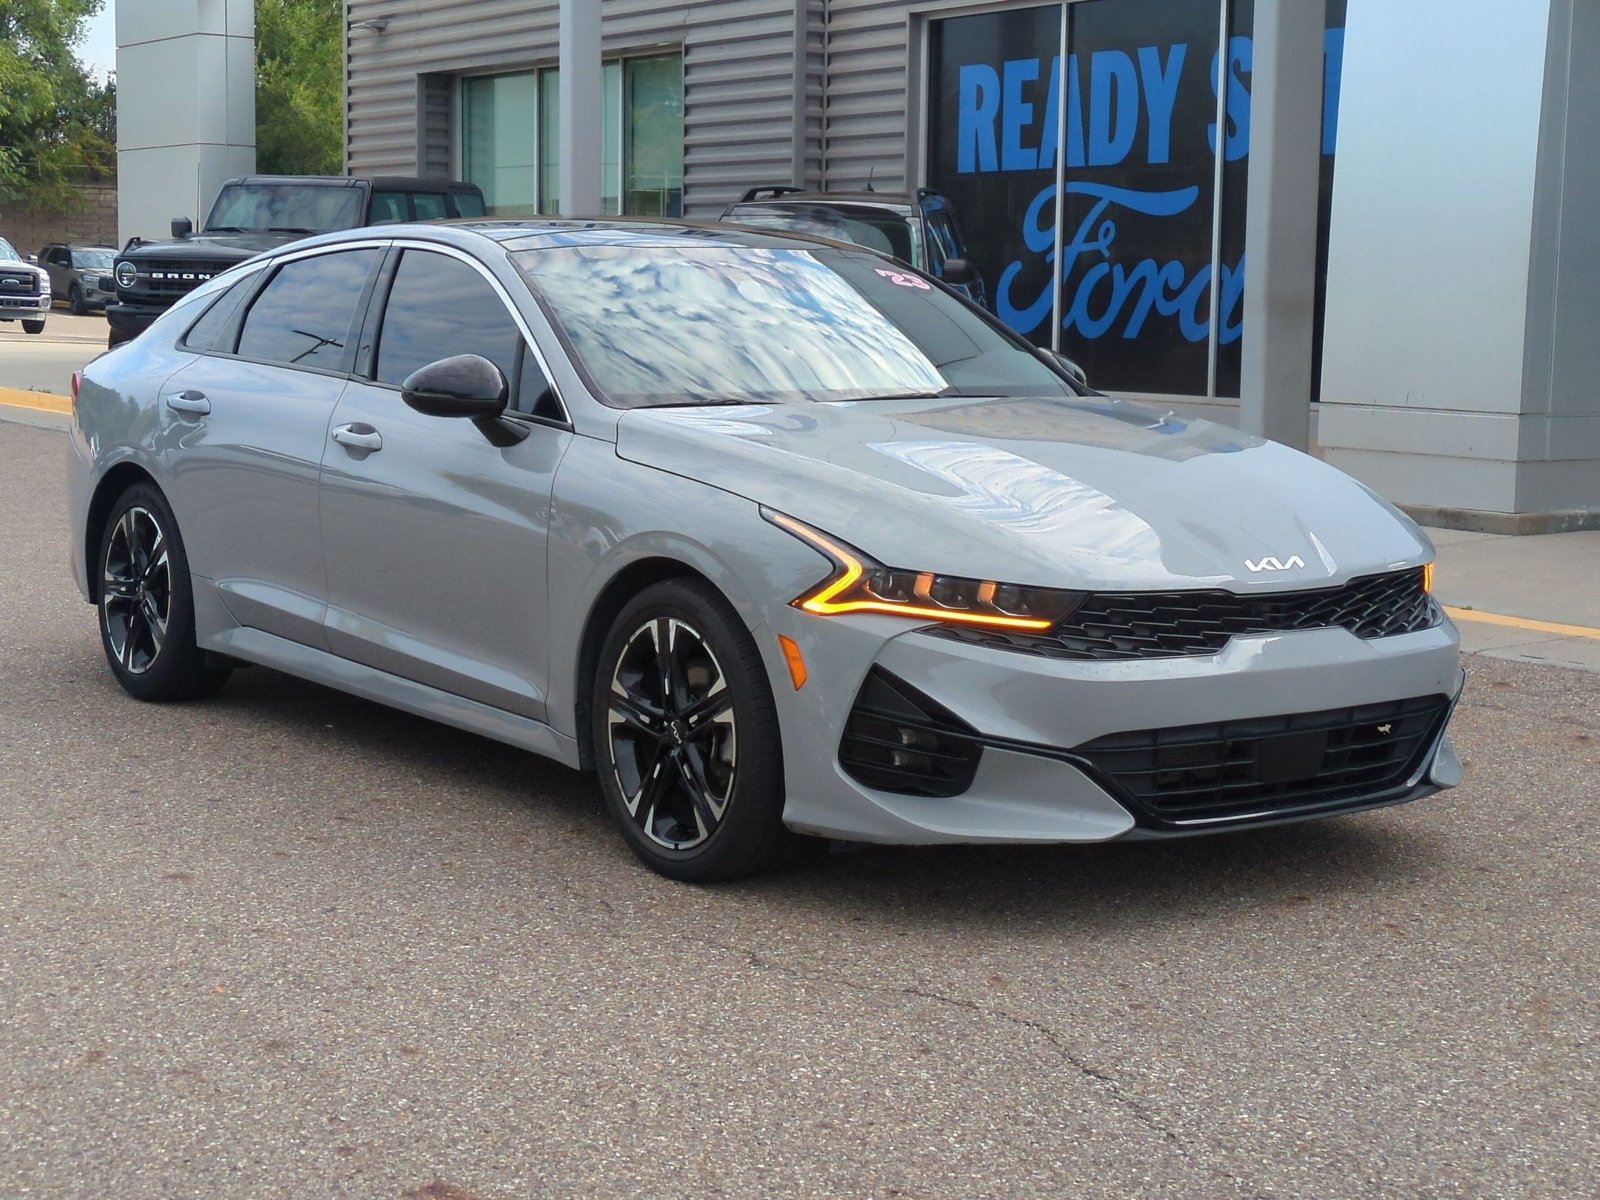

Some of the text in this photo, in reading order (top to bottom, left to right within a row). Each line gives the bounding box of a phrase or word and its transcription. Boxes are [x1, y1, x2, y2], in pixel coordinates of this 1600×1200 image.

[957, 43, 1188, 174] READY
[152, 272, 219, 280] BRON
[996, 181, 1246, 345] Ford
[1244, 555, 1305, 572] KIA
